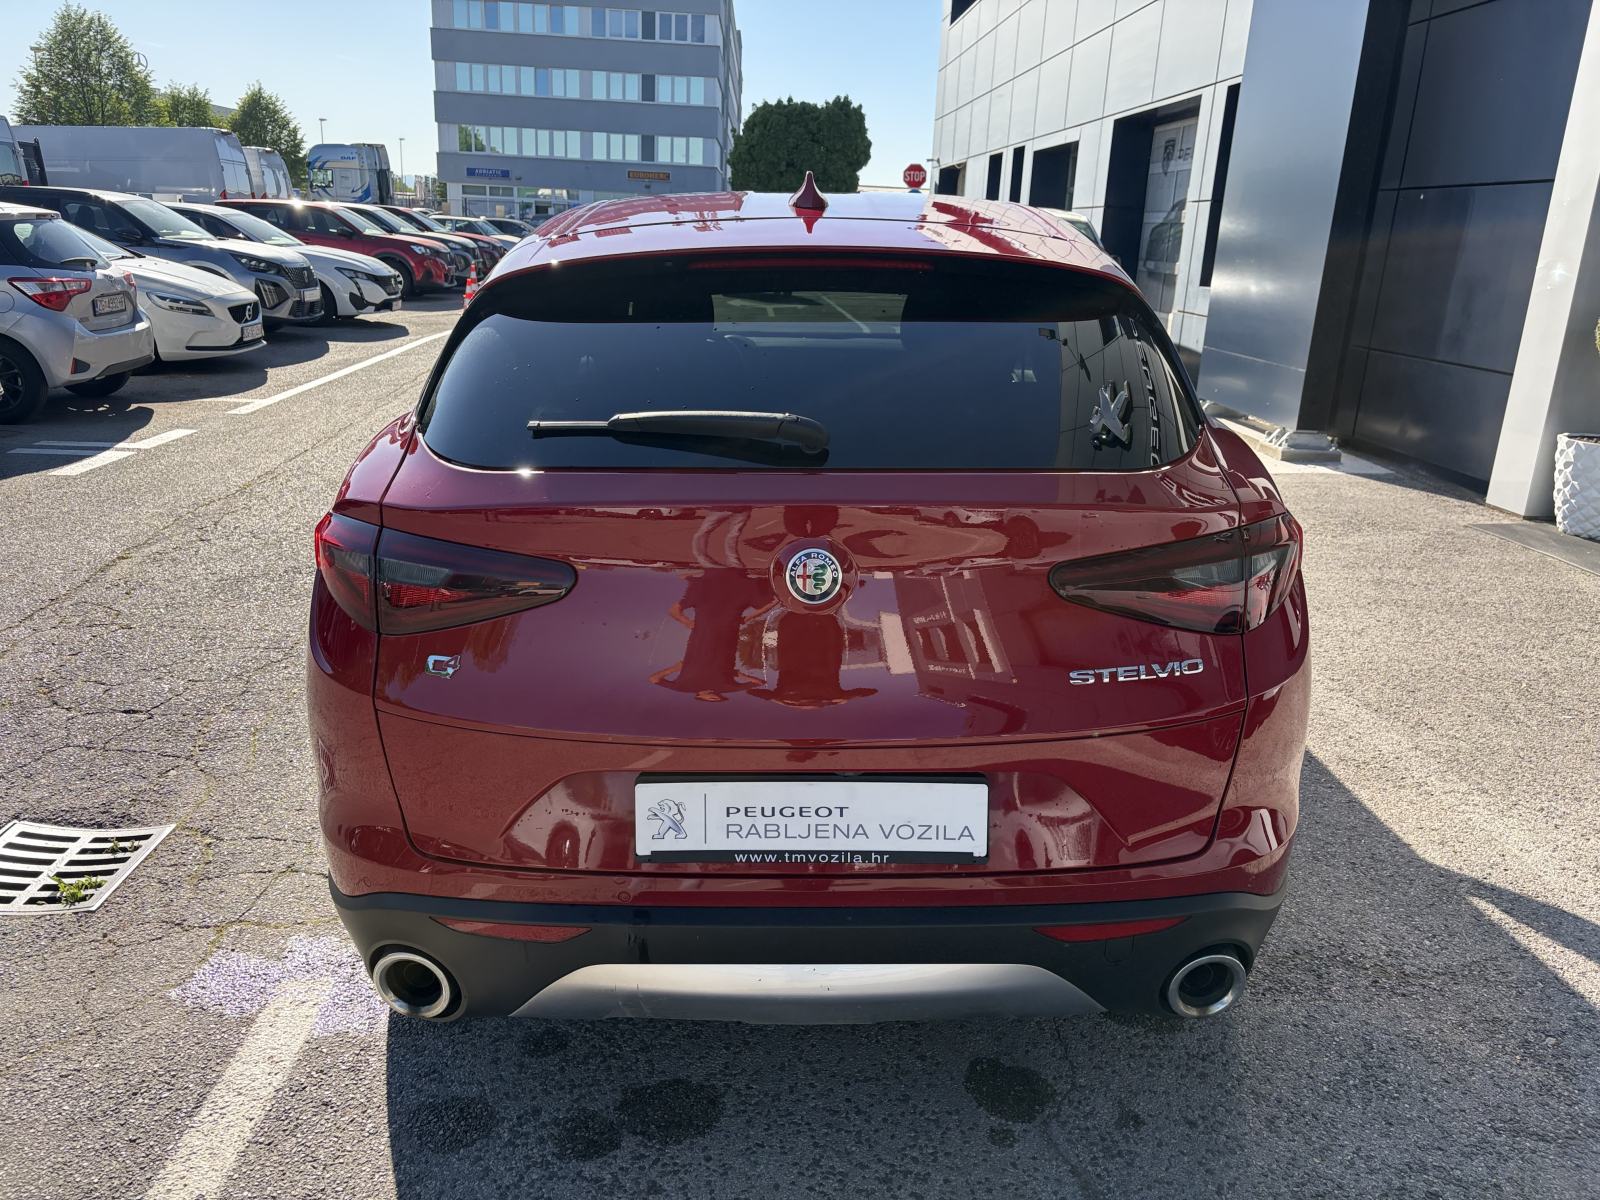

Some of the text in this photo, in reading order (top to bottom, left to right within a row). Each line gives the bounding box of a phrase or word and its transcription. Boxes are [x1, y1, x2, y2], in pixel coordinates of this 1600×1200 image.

[904, 171, 925, 181] STOP
[790, 552, 838, 578] ALFA ROMEO
[1069, 658, 1203, 685] STELVIO
[726, 806, 849, 818] PEUGEOT
[726, 823, 976, 842] RABLJENA VOZILA
[735, 851, 890, 864] www.tmvozila.hr
